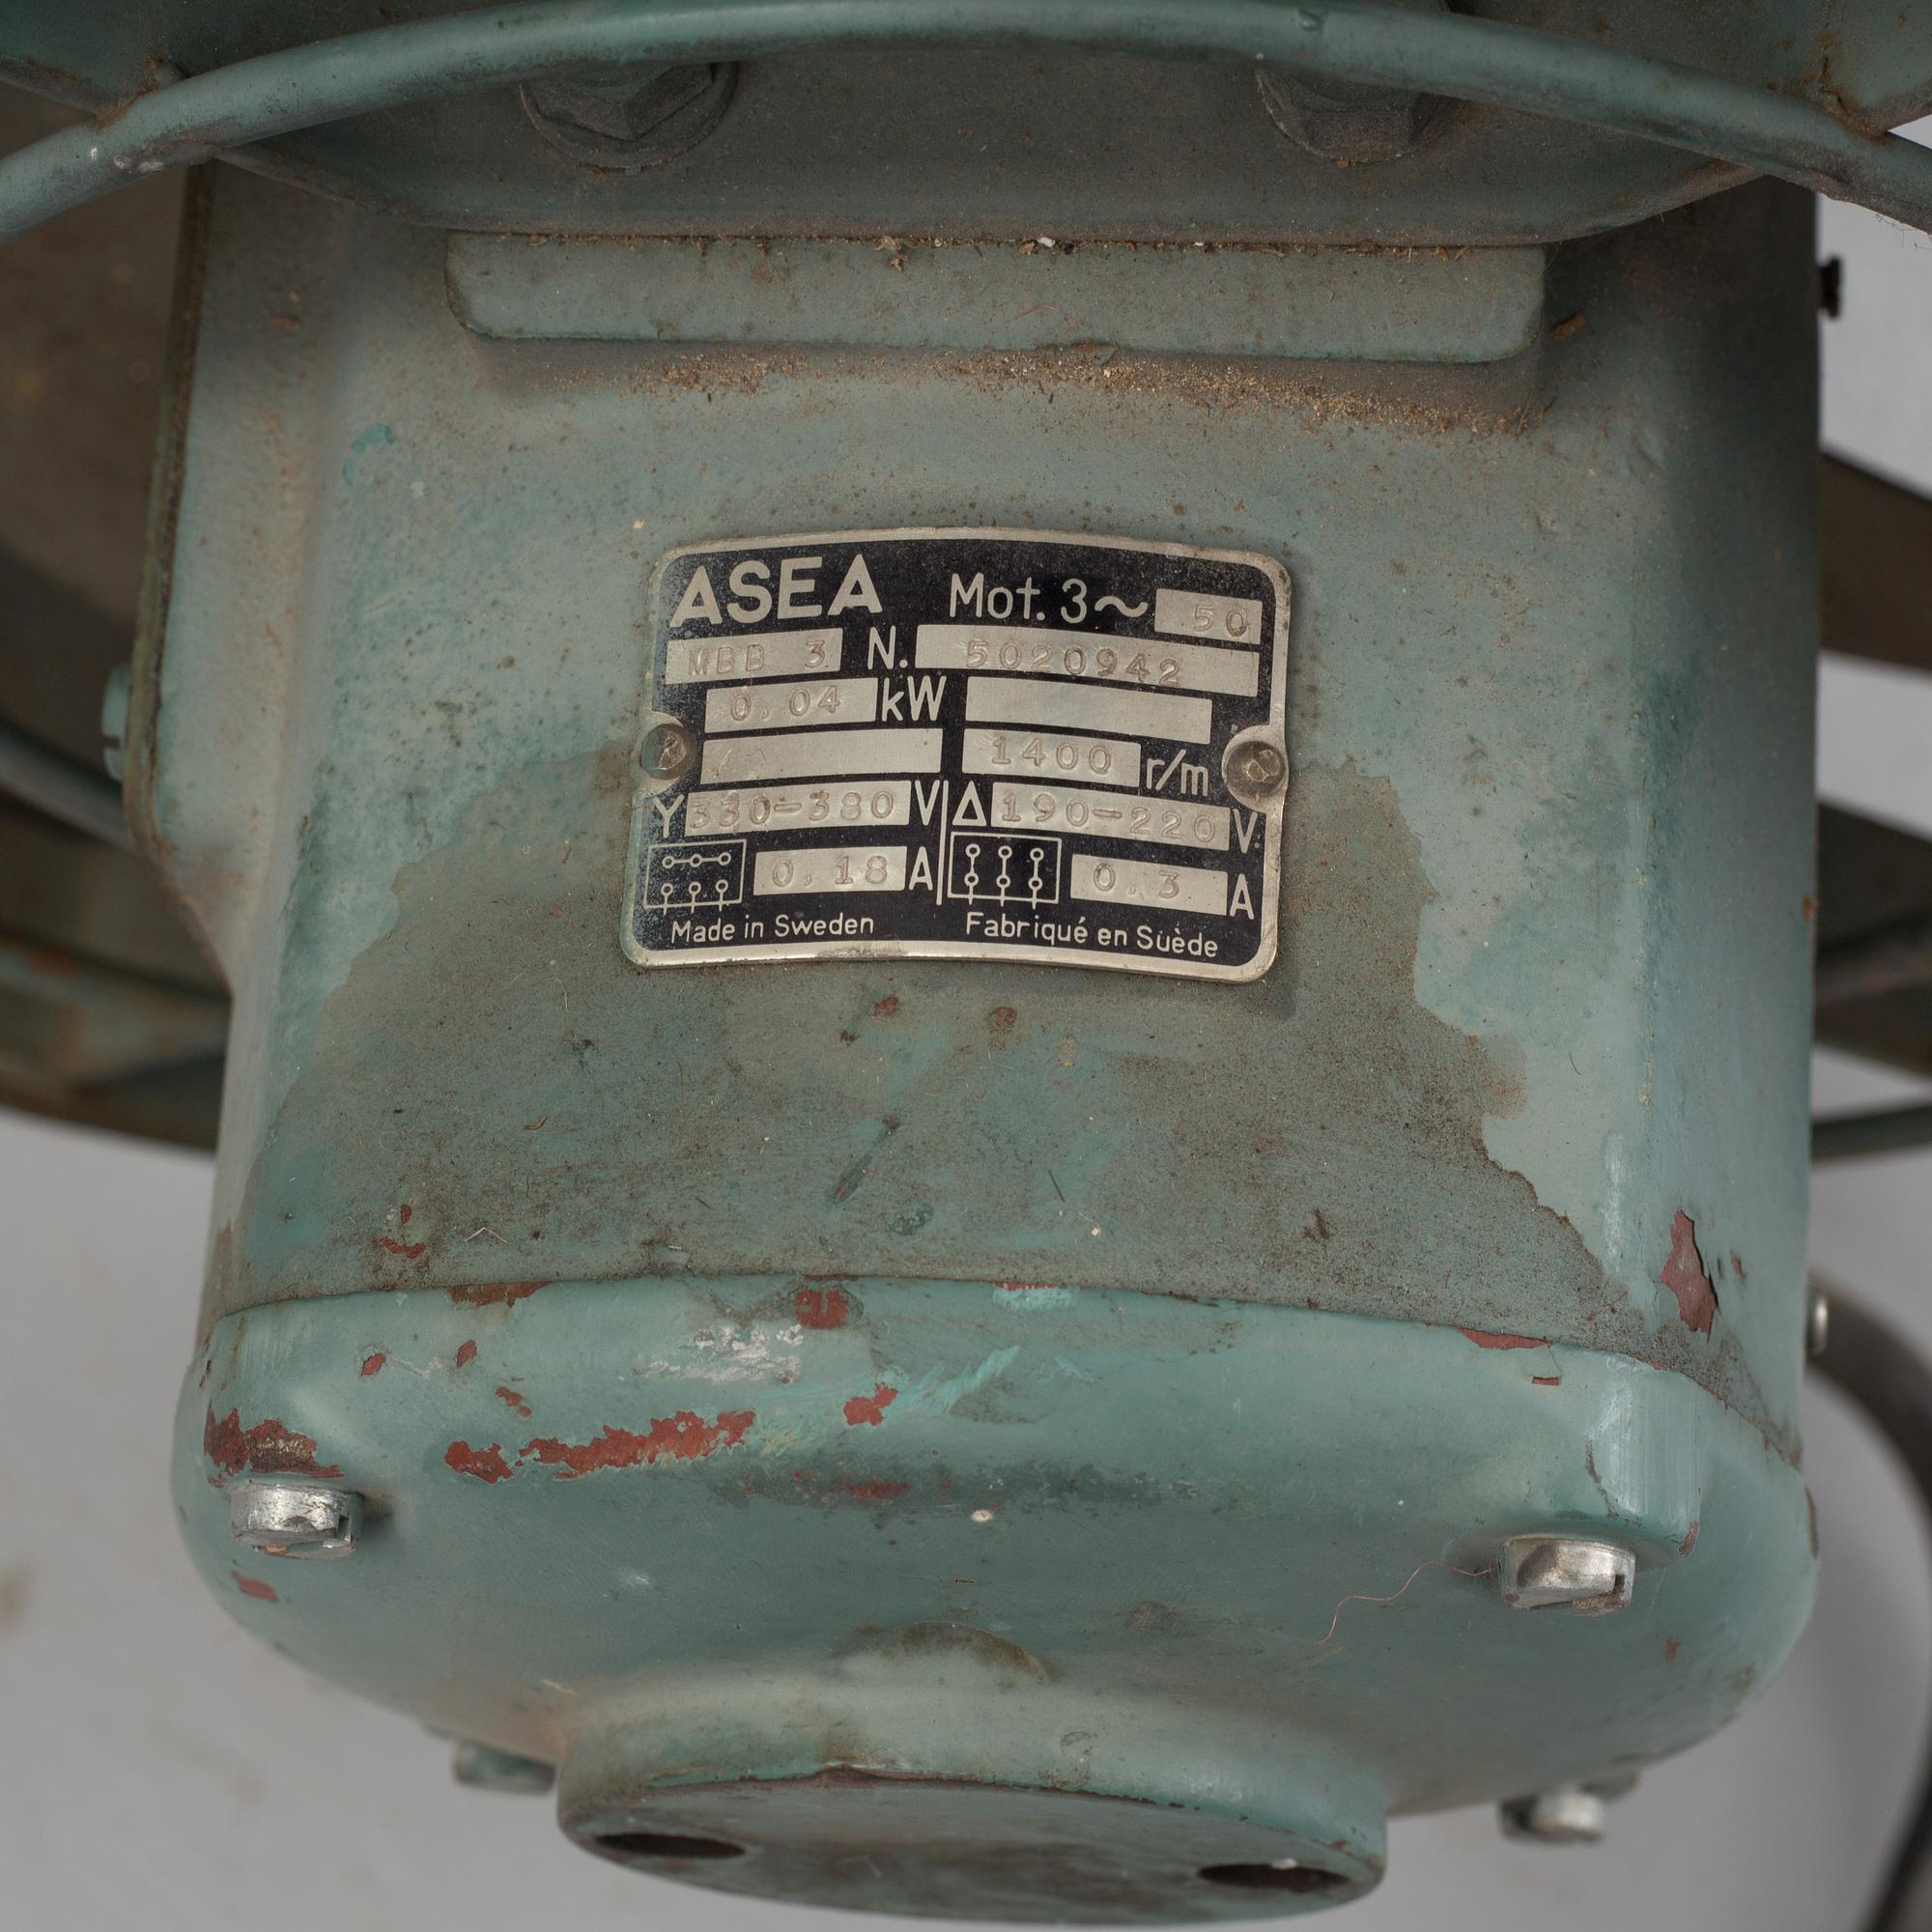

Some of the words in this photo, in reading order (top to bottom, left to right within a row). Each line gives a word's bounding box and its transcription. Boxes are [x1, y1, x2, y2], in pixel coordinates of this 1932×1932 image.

[669, 554, 883, 628] ASEA
[949, 572, 1046, 621] Mot.
[1192, 603, 1250, 638] 50
[804, 639, 827, 669] 3
[867, 625, 908, 670] N.
[966, 638, 1181, 687] 5020942
[881, 675, 947, 722] kW
[991, 733, 1113, 775] 1400
[1146, 749, 1209, 797] r/m
[914, 780, 941, 827] V
[1001, 791, 1216, 843] 190-220
[1232, 809, 1258, 854] V
[908, 846, 933, 891] A
[1229, 873, 1255, 920] A
[671, 919, 735, 944] Made
[744, 915, 763, 939] in
[775, 913, 874, 937] Sweden
[966, 912, 1088, 946] Fabriqué
[1097, 927, 1127, 947] en
